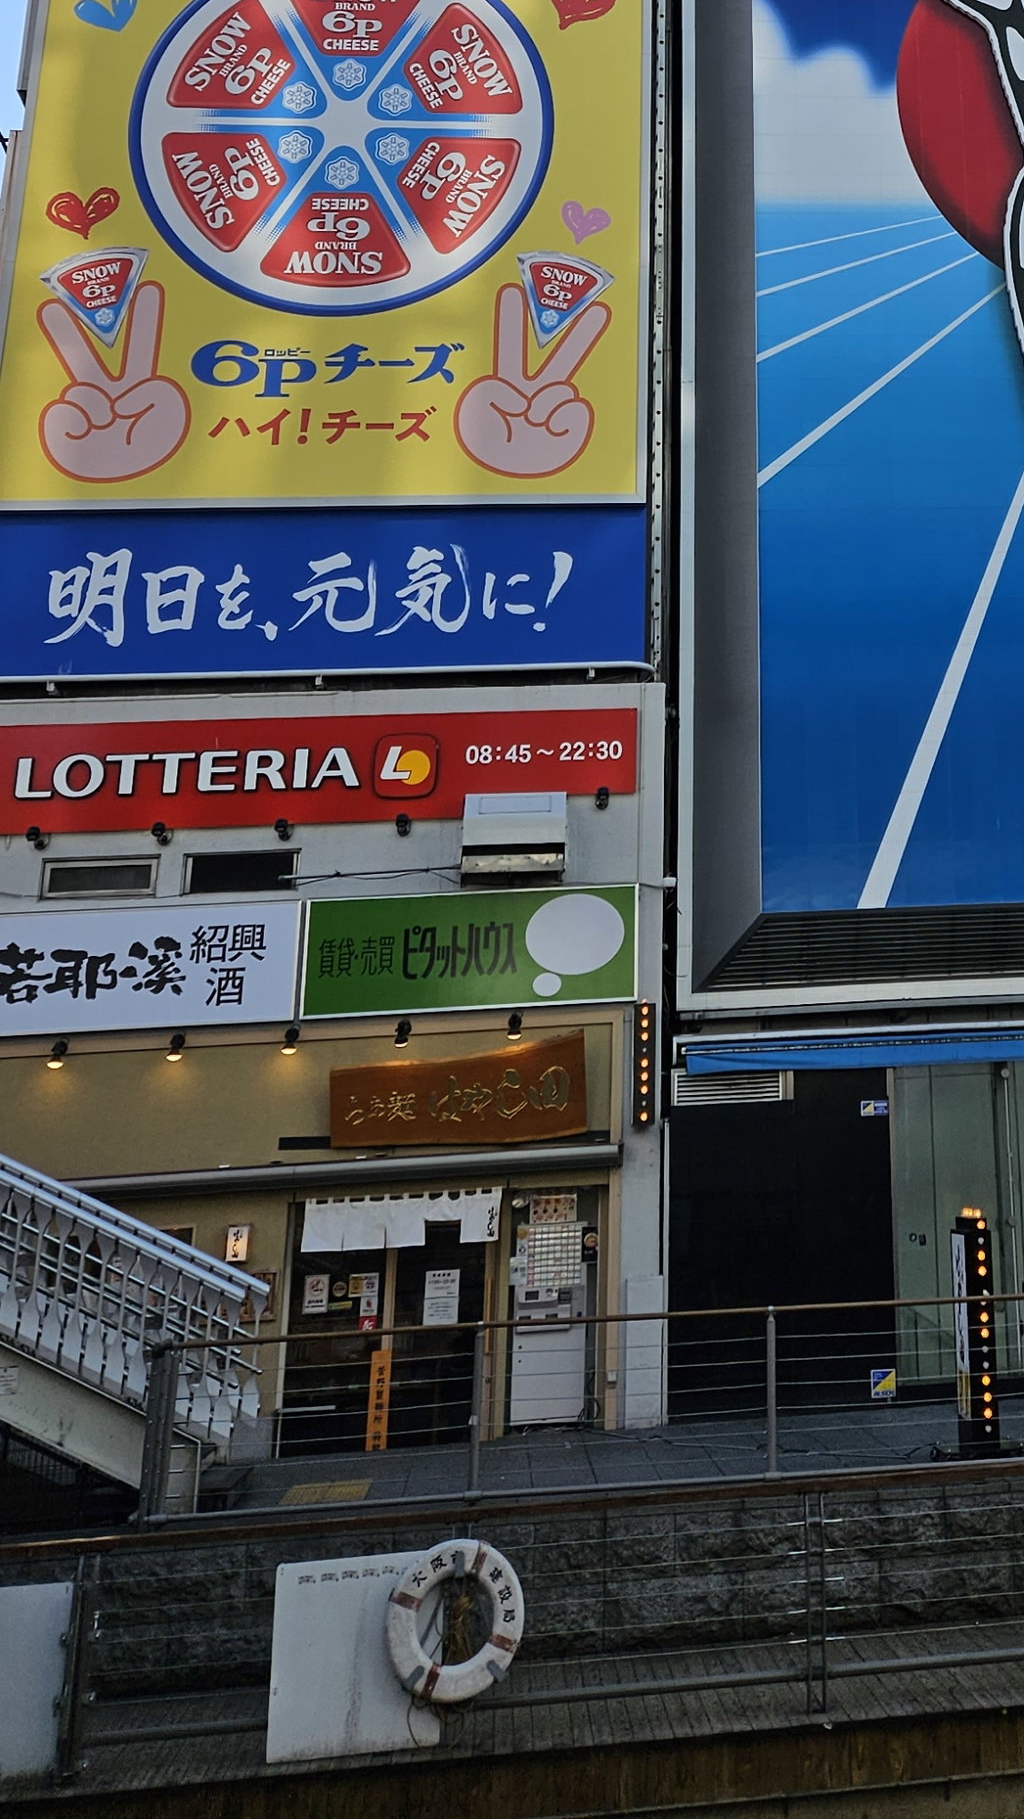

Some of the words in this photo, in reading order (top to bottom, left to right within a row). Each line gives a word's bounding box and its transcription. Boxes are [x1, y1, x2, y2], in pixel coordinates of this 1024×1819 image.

[335, 2, 376, 11] BRAND
[184, 11, 252, 92] SNOW
[219, 44, 248, 77] BRAND
[323, 39, 379, 51] CHEESE
[451, 23, 513, 97] SNOW
[250, 58, 291, 105] CHEESE
[453, 51, 477, 85] BRAND
[409, 63, 443, 109] CHEESE
[245, 137, 281, 187] CHEESE
[401, 142, 440, 189] CHEESE
[171, 151, 236, 229] SNOW
[209, 164, 233, 199] BRAND
[442, 155, 506, 238] SNOW
[446, 171, 472, 204] BRAND
[311, 197, 370, 210] CHEESE
[283, 250, 384, 275] SNOW
[314, 240, 357, 250] BRAND
[72, 261, 121, 284] SNOW
[540, 266, 588, 286] SNOW
[14, 747, 360, 800] LOTTERIA
[402, 921, 518, 980] ピタットハウス
